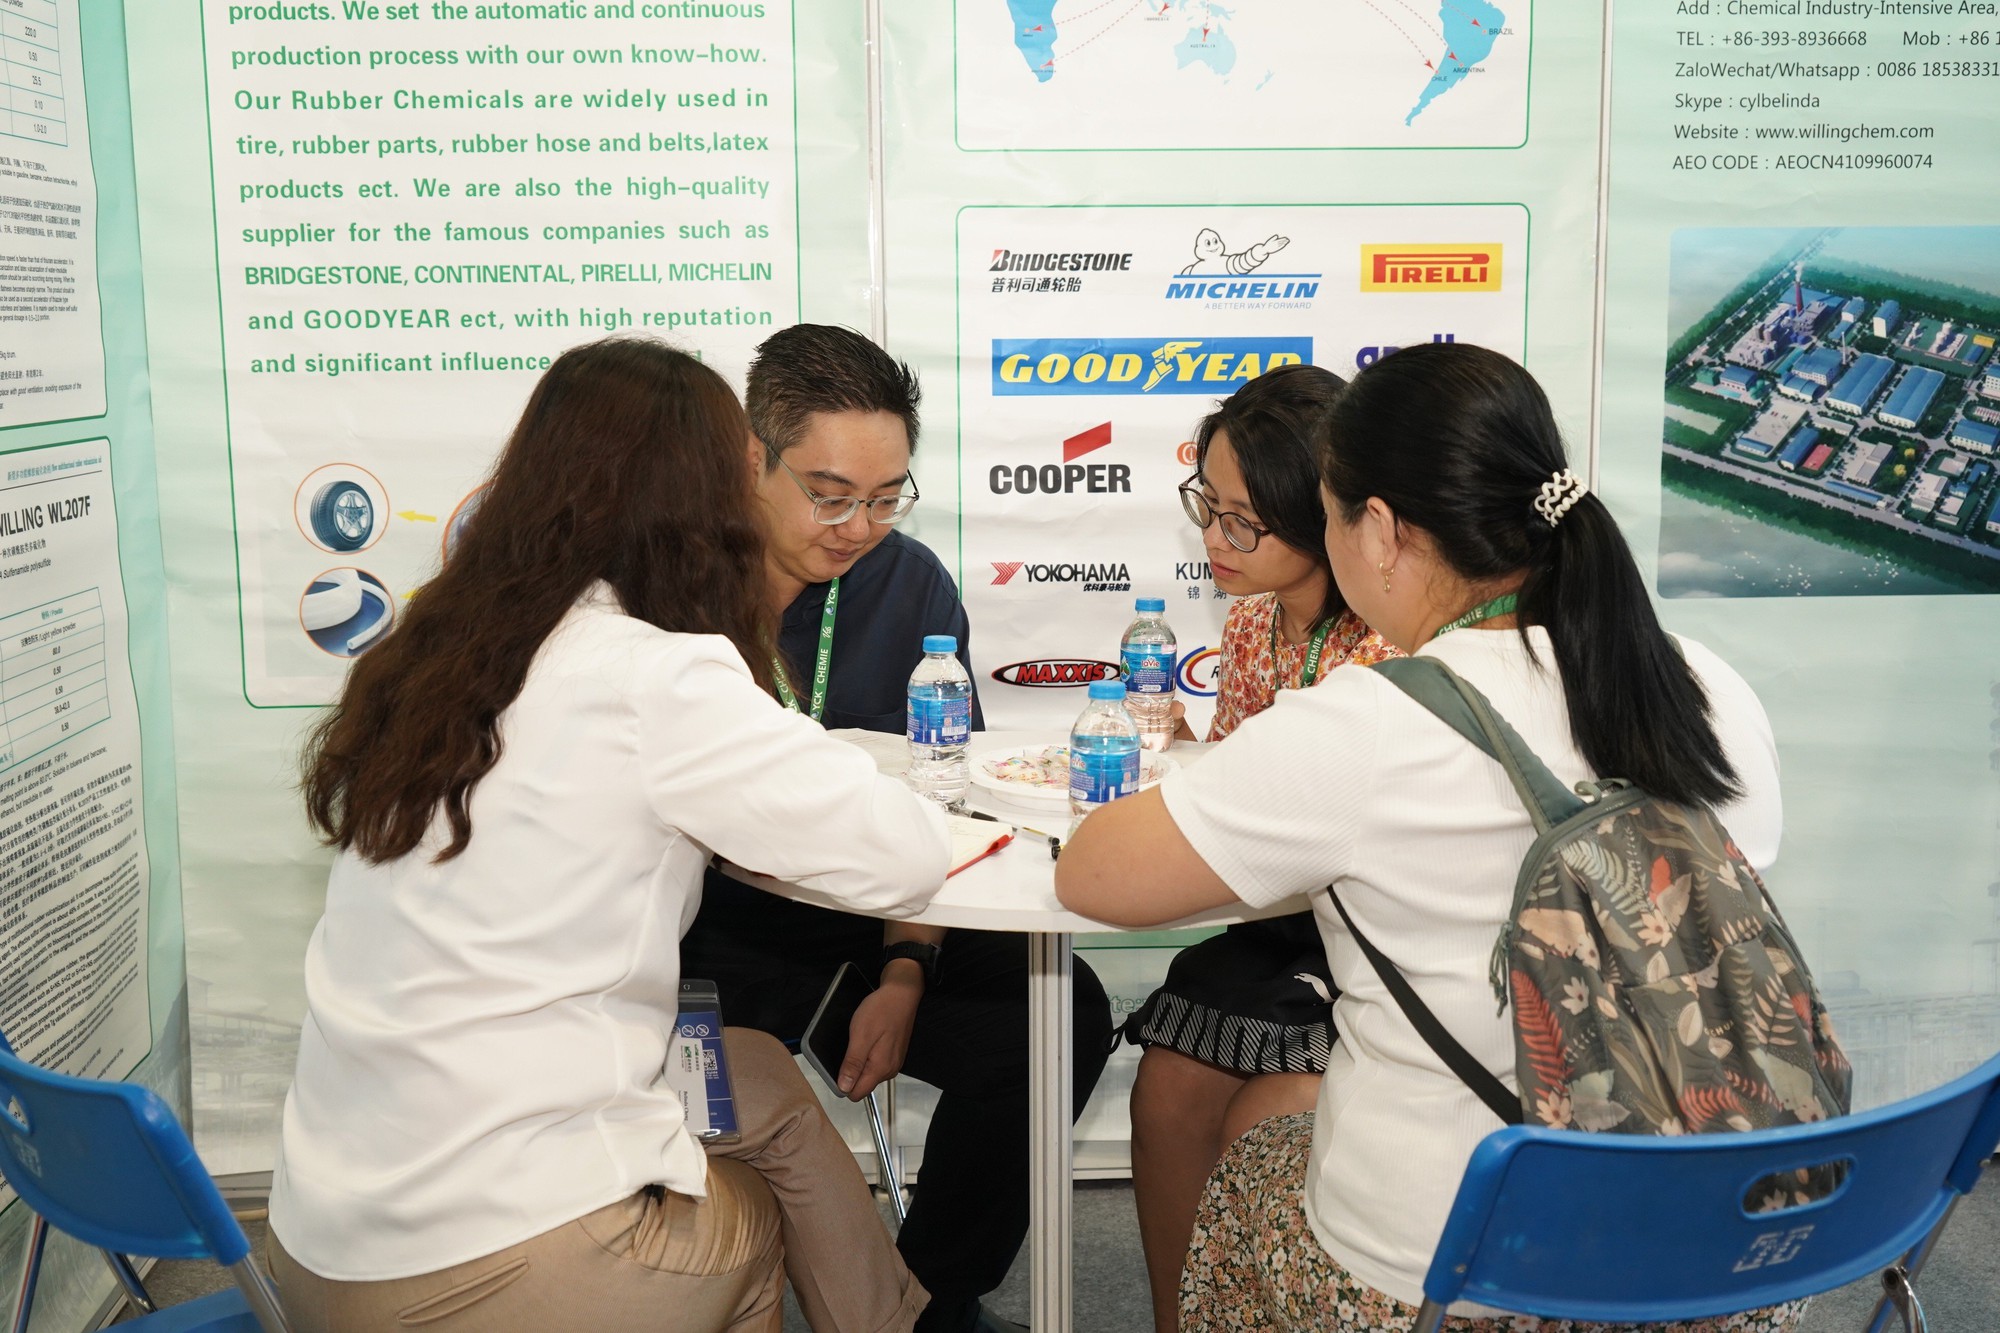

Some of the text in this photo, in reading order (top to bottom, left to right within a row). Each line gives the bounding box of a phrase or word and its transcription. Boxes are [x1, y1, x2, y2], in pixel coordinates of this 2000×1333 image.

[229, 0, 765, 24] products. We set the automatic and continuous
[1677, 0, 1709, 15] Add
[1728, 0, 1800, 15] Chemical
[1806, 0, 1952, 19] Industry-Intensive
[1958, 0, 1998, 16] Area,
[1677, 32, 1704, 45] TEL
[1723, 31, 1866, 46] +86-393-8936668
[1903, 31, 1940, 45] Mob
[1959, 31, 1989, 45] +86
[232, 46, 361, 69] production
[370, 51, 458, 69] process
[466, 45, 518, 64] with
[527, 50, 564, 64] our
[573, 50, 622, 63] own
[1676, 62, 1859, 80] ZaloWechat/Whatsapp
[1878, 62, 1916, 76] 0086
[1923, 62, 1999, 76] 18538331
[235, 88, 767, 111] Our Rubber Chemicals are widely used in
[1676, 93, 1722, 112] Skype
[1740, 93, 1819, 112] cylbelinda
[1674, 124, 1738, 139] Website
[1756, 123, 1933, 142] www.willingchem.com
[236, 135, 283, 156] tire,
[293, 135, 369, 154] rubber
[378, 136, 443, 158] parts,
[452, 134, 528, 153] rubber
[537, 133, 590, 152] hose
[599, 133, 640, 152] and
[1673, 155, 1706, 169] AEO
[1713, 155, 1758, 169] CODE
[1776, 154, 1932, 169] AEOCN4109960074
[240, 179, 343, 203] products
[359, 181, 398, 197] ect.
[413, 178, 450, 197] We
[466, 183, 500, 197] are
[515, 178, 560, 196] also
[575, 177, 612, 196] the
[243, 220, 769, 246] supplier for the famous companies such as
[989, 250, 1132, 271] BRIDGESTONE
[1373, 254, 1490, 283] PIRELLI
[245, 263, 771, 286] BRIDGESTONE, CONTINENTAL, PIRELLI, MICHELIN
[992, 277, 1081, 292] 普利司通轮胎
[1166, 283, 1319, 298] MICHELIN
[249, 307, 771, 331] and GOODYEAR ect, with high reputation
[251, 354, 295, 373] and
[305, 353, 432, 376] significant
[442, 352, 554, 373] influence
[990, 464, 1131, 494] COOPER
[48, 496, 90, 524] WL207F
[1025, 564, 1130, 582] YOKOHAMA
[1439, 607, 1484, 636] CHEMIE
[817, 649, 828, 684] CHEMIE
[1308, 636, 1322, 674] CHEMIE
[1016, 664, 1106, 683] MAXXIS
